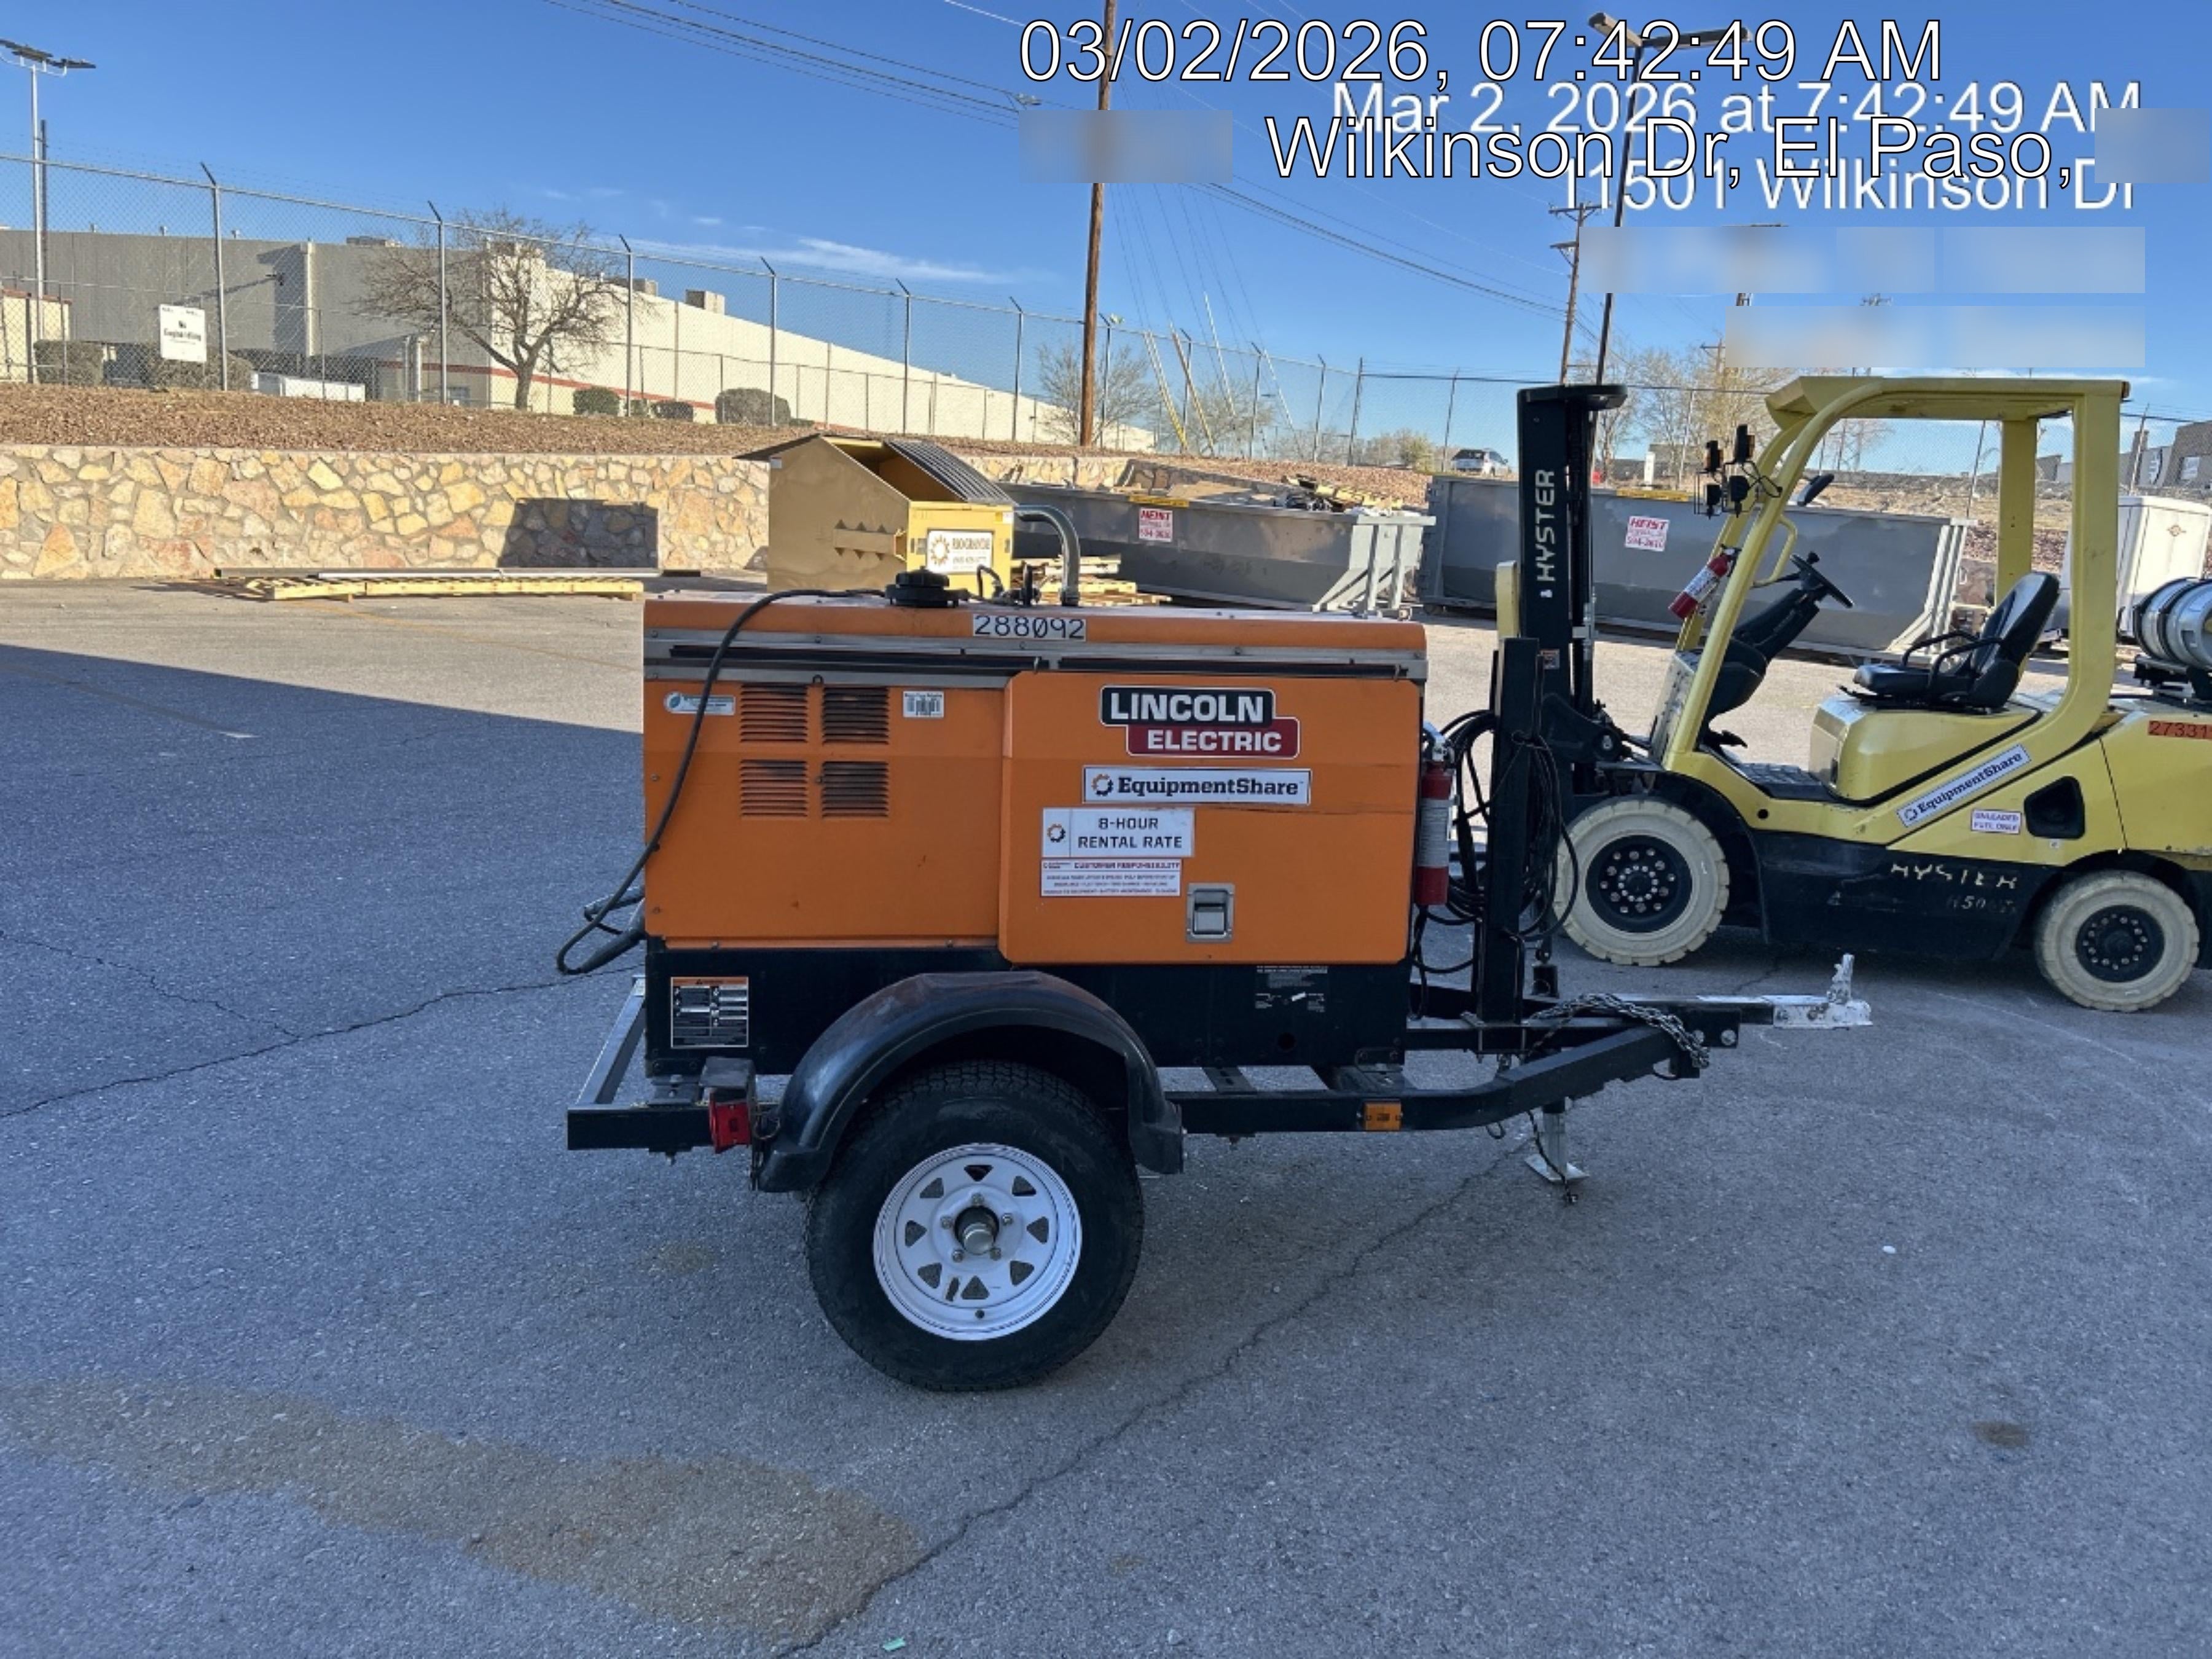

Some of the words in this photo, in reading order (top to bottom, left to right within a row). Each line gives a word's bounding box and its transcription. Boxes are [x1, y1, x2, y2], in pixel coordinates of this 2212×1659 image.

[1535, 469, 1555, 581] HYSTER
[975, 616, 1085, 639] 288092
[1110, 692, 1264, 723] LINCOLN
[1147, 729, 1282, 751] ELECTRIC
[2149, 721, 2212, 739] 27331
[1118, 776, 1299, 797] EquipmentShare
[1917, 753, 2023, 814] EquipmentShare
[1099, 817, 1158, 830] 8-HOUR
[1078, 836, 1137, 849] RENTAL
[1143, 836, 1182, 849] RATE
